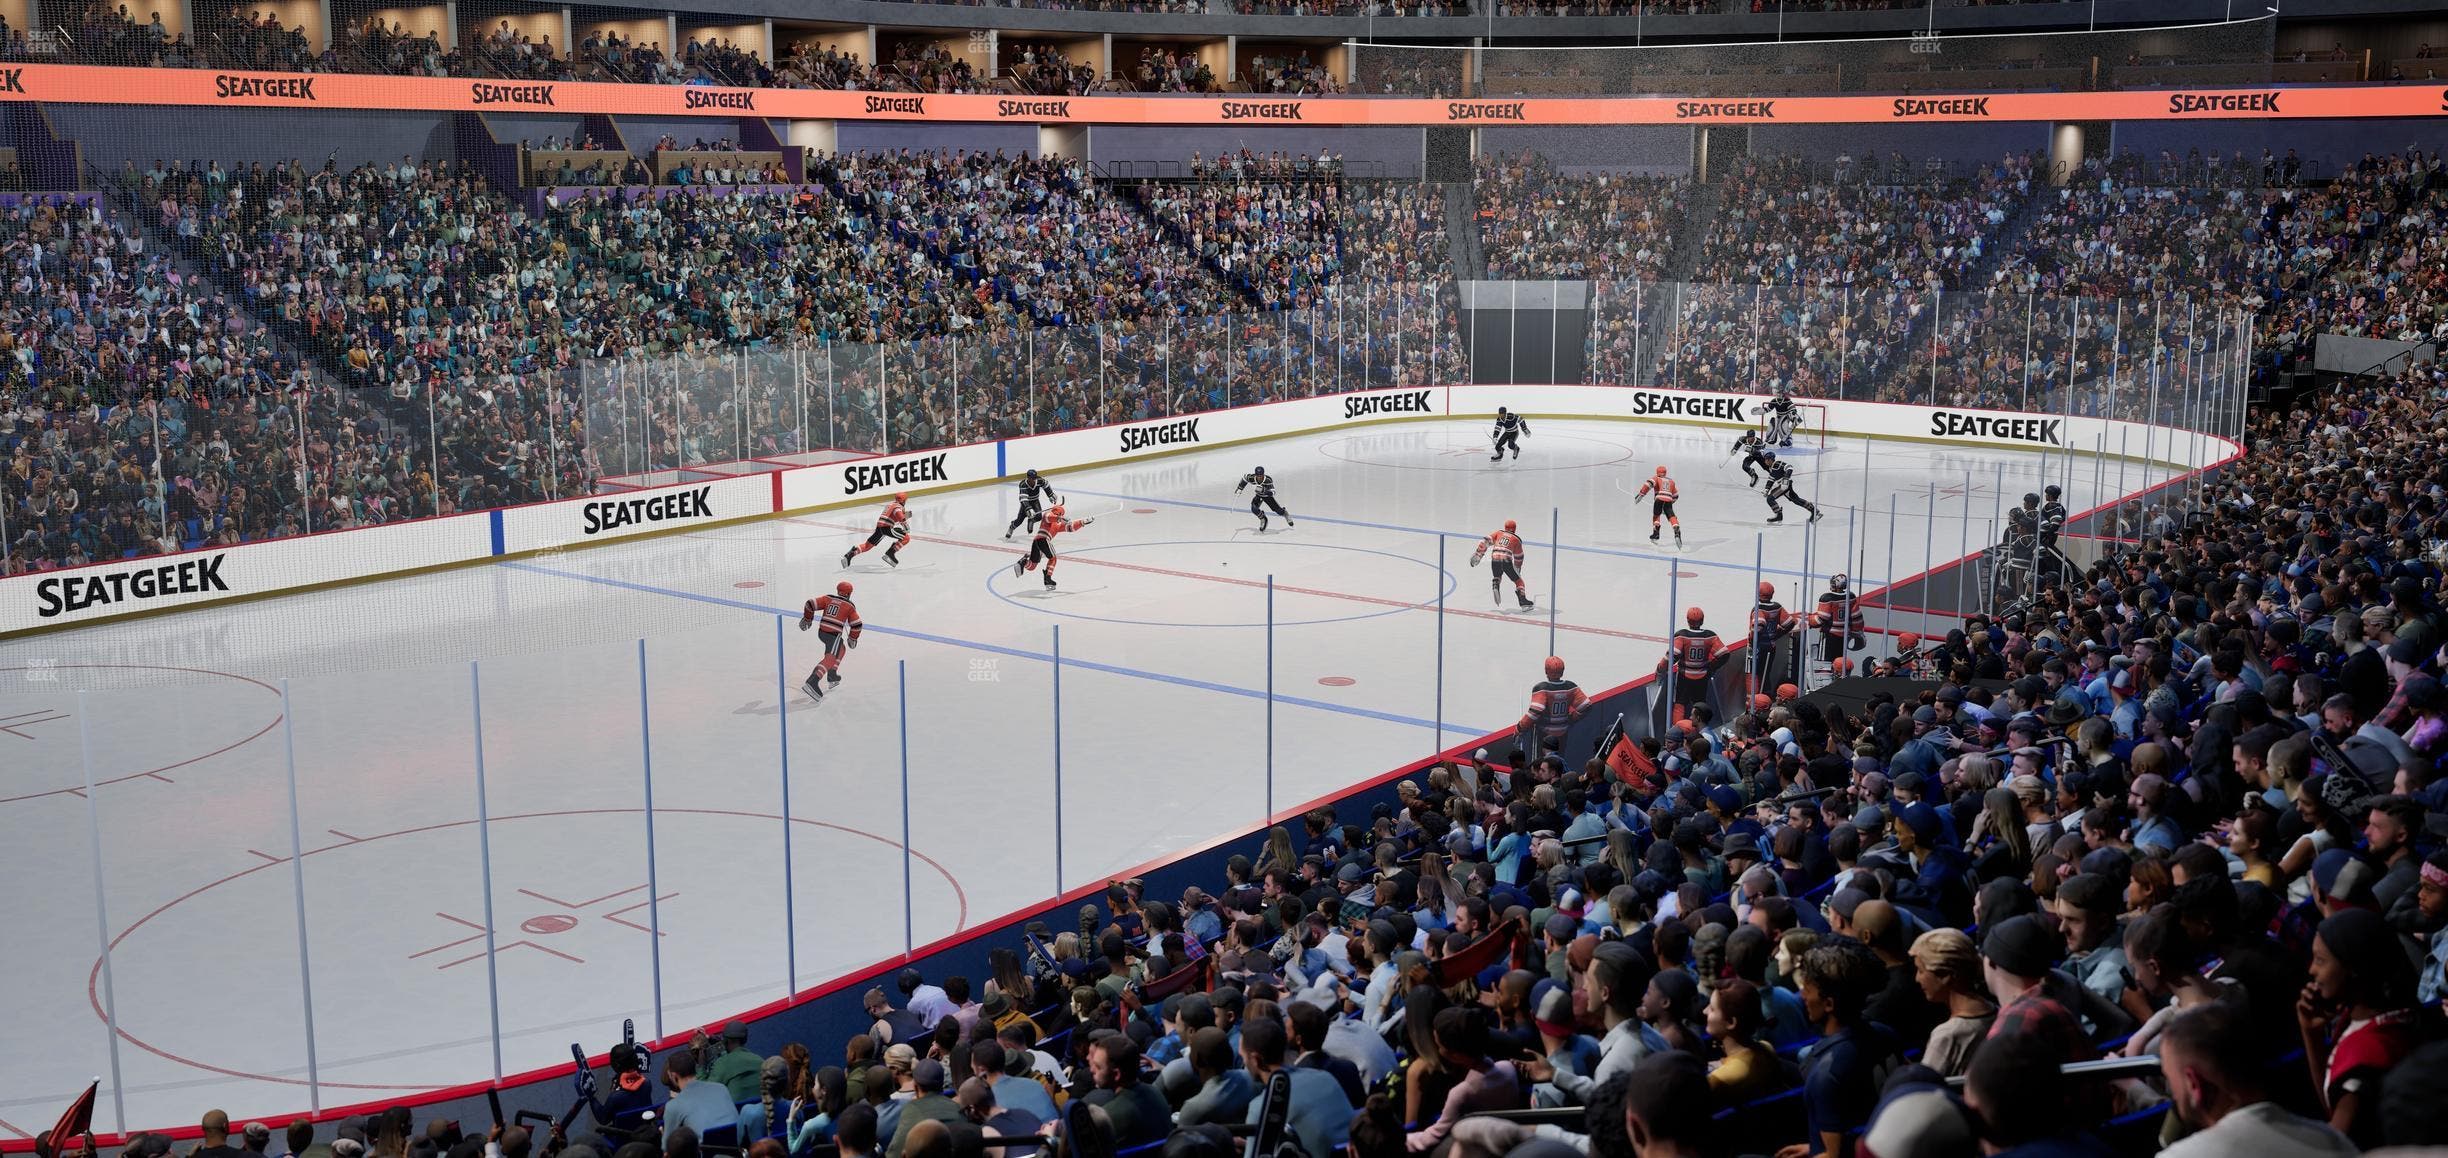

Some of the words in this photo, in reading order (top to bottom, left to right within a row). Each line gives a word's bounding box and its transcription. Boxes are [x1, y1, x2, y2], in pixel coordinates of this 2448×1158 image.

[215, 75, 316, 101] SEATGEEK
[471, 82, 555, 106] SEATGEEK
[685, 89, 755, 111] SEATGEEK
[866, 96, 925, 115] SEATGEEK
[999, 100, 1070, 118] SEATGEEK
[1221, 101, 1302, 120] SEATGEEK
[1676, 101, 1775, 119] SEATGEEK
[1893, 97, 1989, 117] SEATGEEK
[2169, 91, 2281, 114] SEATGEEK
[1448, 102, 1525, 121] SEATGEEK
[1345, 390, 1431, 419] SEATGEEK
[1633, 391, 1745, 423] SEATGEEK
[1120, 417, 1200, 453] SEATGEEK
[1931, 411, 2061, 446] SEATGEEK
[844, 452, 948, 495] SEATGEEK
[583, 485, 713, 535] SEATGEEK
[37, 552, 230, 619] SEATGEEK
[825, 603, 840, 616] 00
[1688, 647, 1705, 660] 00
[1552, 701, 1568, 716] 00
